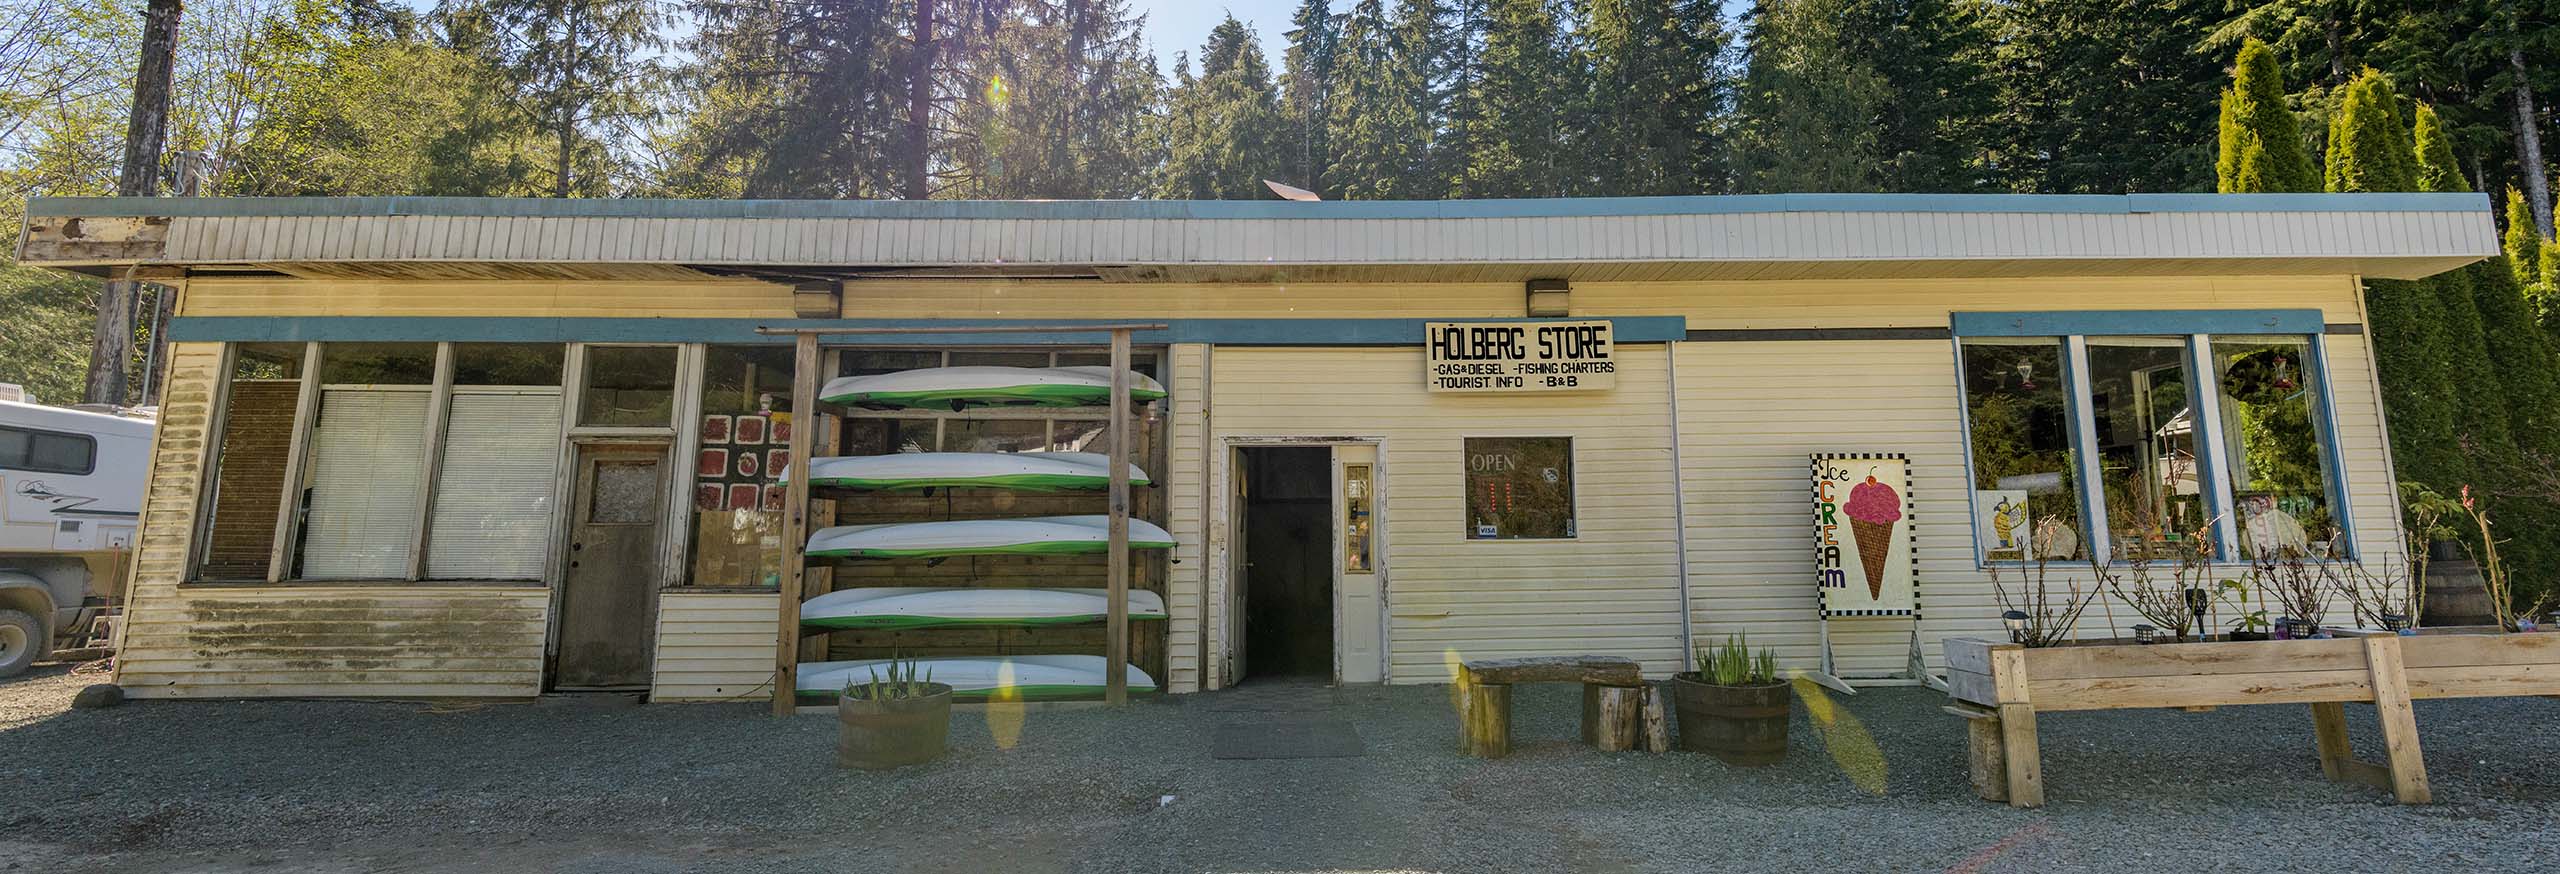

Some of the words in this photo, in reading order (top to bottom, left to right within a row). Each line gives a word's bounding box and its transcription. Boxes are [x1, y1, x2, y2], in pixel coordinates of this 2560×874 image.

[1432, 327, 1525, 360] HOLBERG
[1538, 326, 1608, 359] STORE
[1513, 363, 1558, 374] -FISHING
[1561, 362, 1614, 374] CHARTERS
[1496, 377, 1523, 387] INFO
[1471, 454, 1516, 471] OPEN
[1818, 459, 1850, 481] Ice
